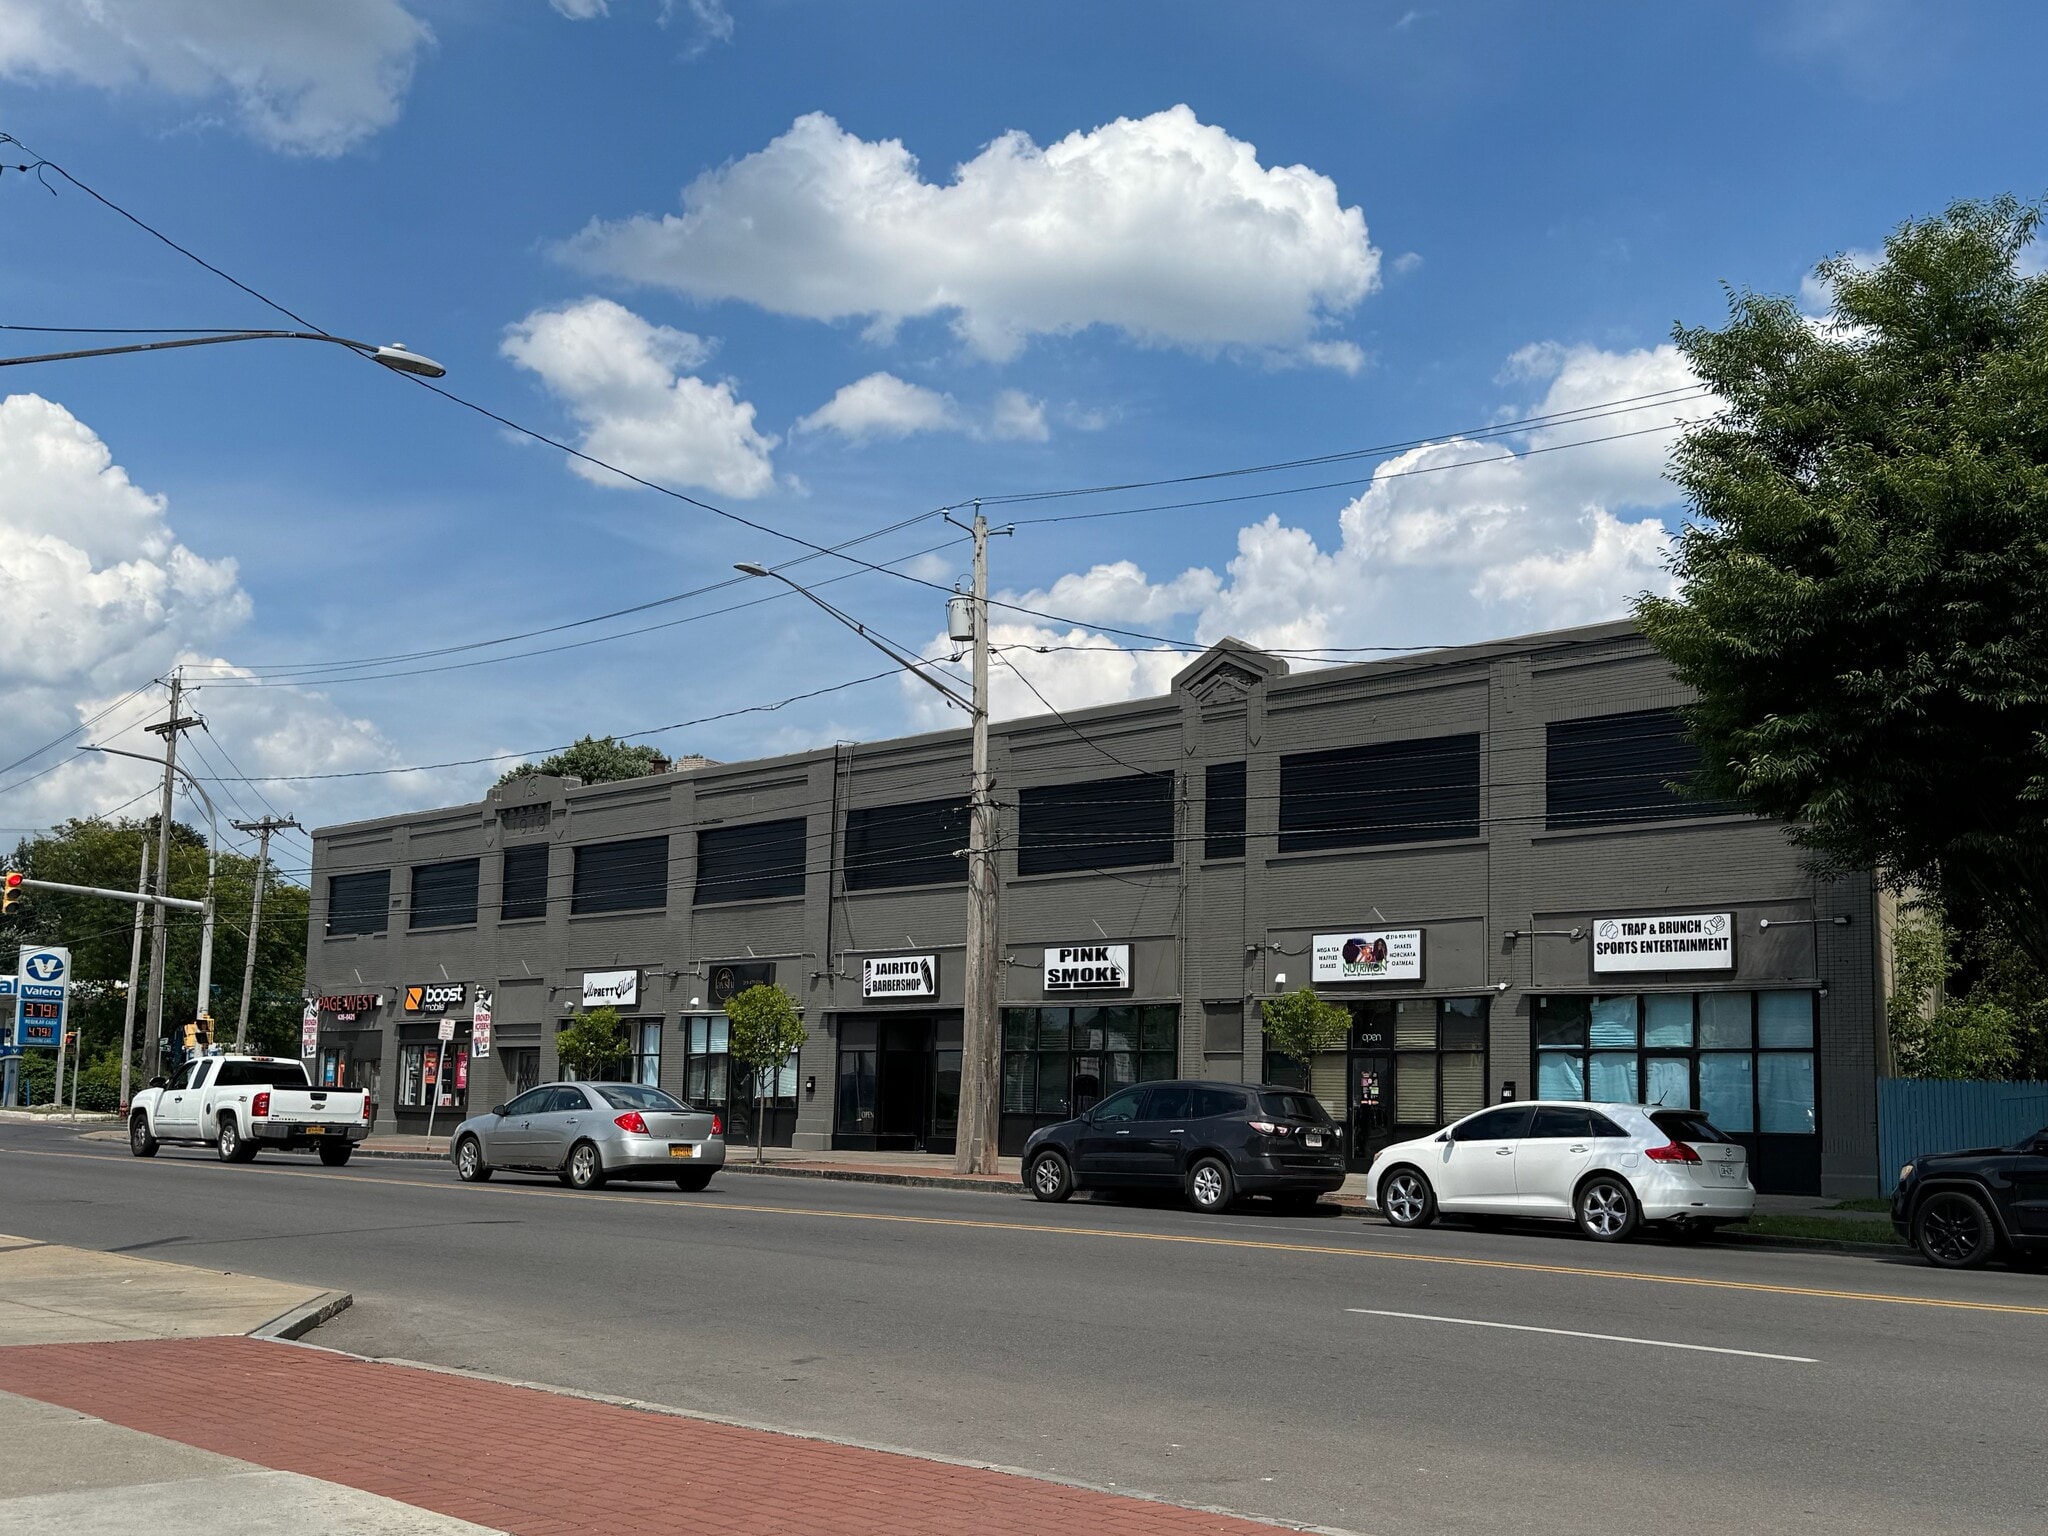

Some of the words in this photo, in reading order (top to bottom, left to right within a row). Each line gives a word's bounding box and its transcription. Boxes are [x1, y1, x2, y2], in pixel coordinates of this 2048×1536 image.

[1621, 922, 1647, 936] TRAP
[1649, 923, 1657, 935] &
[1659, 919, 1702, 935] BRUNCH
[1596, 940, 1638, 955] SPORTS
[1640, 937, 1729, 953] ENTERTAINMENT
[1059, 947, 1109, 963] PINK
[875, 961, 919, 975] JAIRITO
[1048, 967, 1121, 983] SMOKE
[25, 986, 62, 997] Valero
[593, 986, 619, 997] PRETTY
[872, 978, 922, 992] BARBERSHOP
[425, 984, 464, 1002] boost
[318, 996, 342, 1011] PAGE
[345, 994, 375, 1011] WEST
[425, 1002, 445, 1011] mobile
[1361, 1033, 1382, 1042] open
